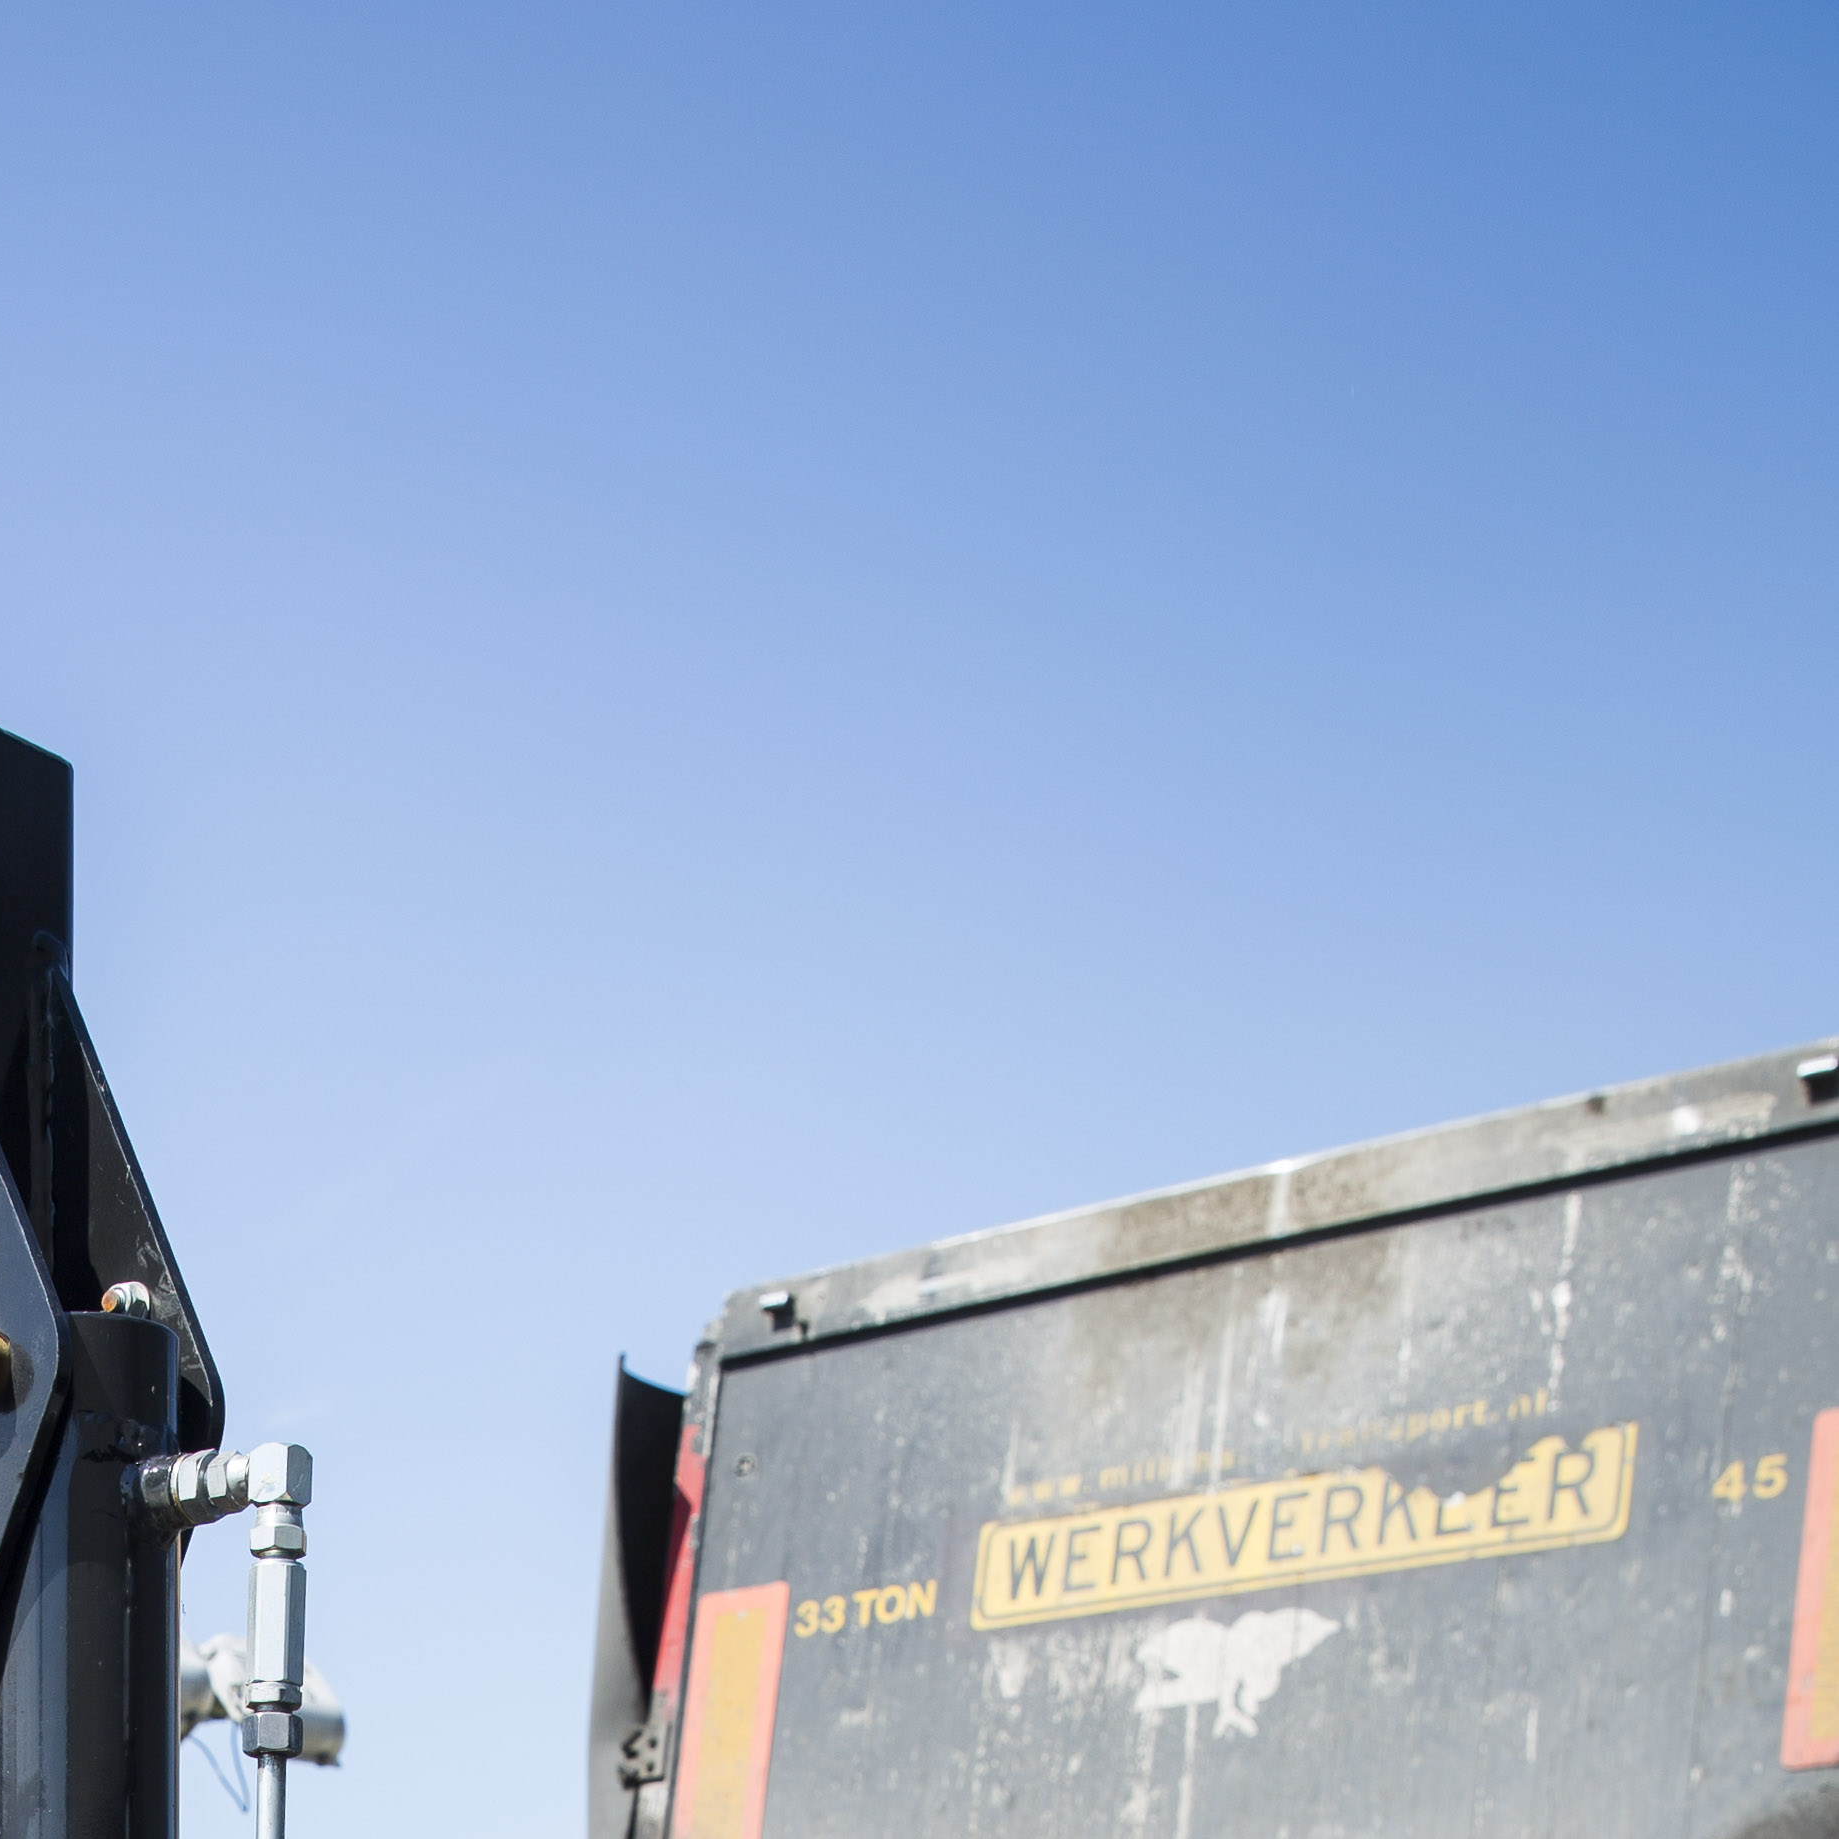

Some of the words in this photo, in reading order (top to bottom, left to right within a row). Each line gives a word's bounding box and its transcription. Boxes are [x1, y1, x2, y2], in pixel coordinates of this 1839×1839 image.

[1712, 1452, 1789, 1502] 45
[793, 1599, 847, 1639] 33
[852, 1579, 938, 1628] TON
